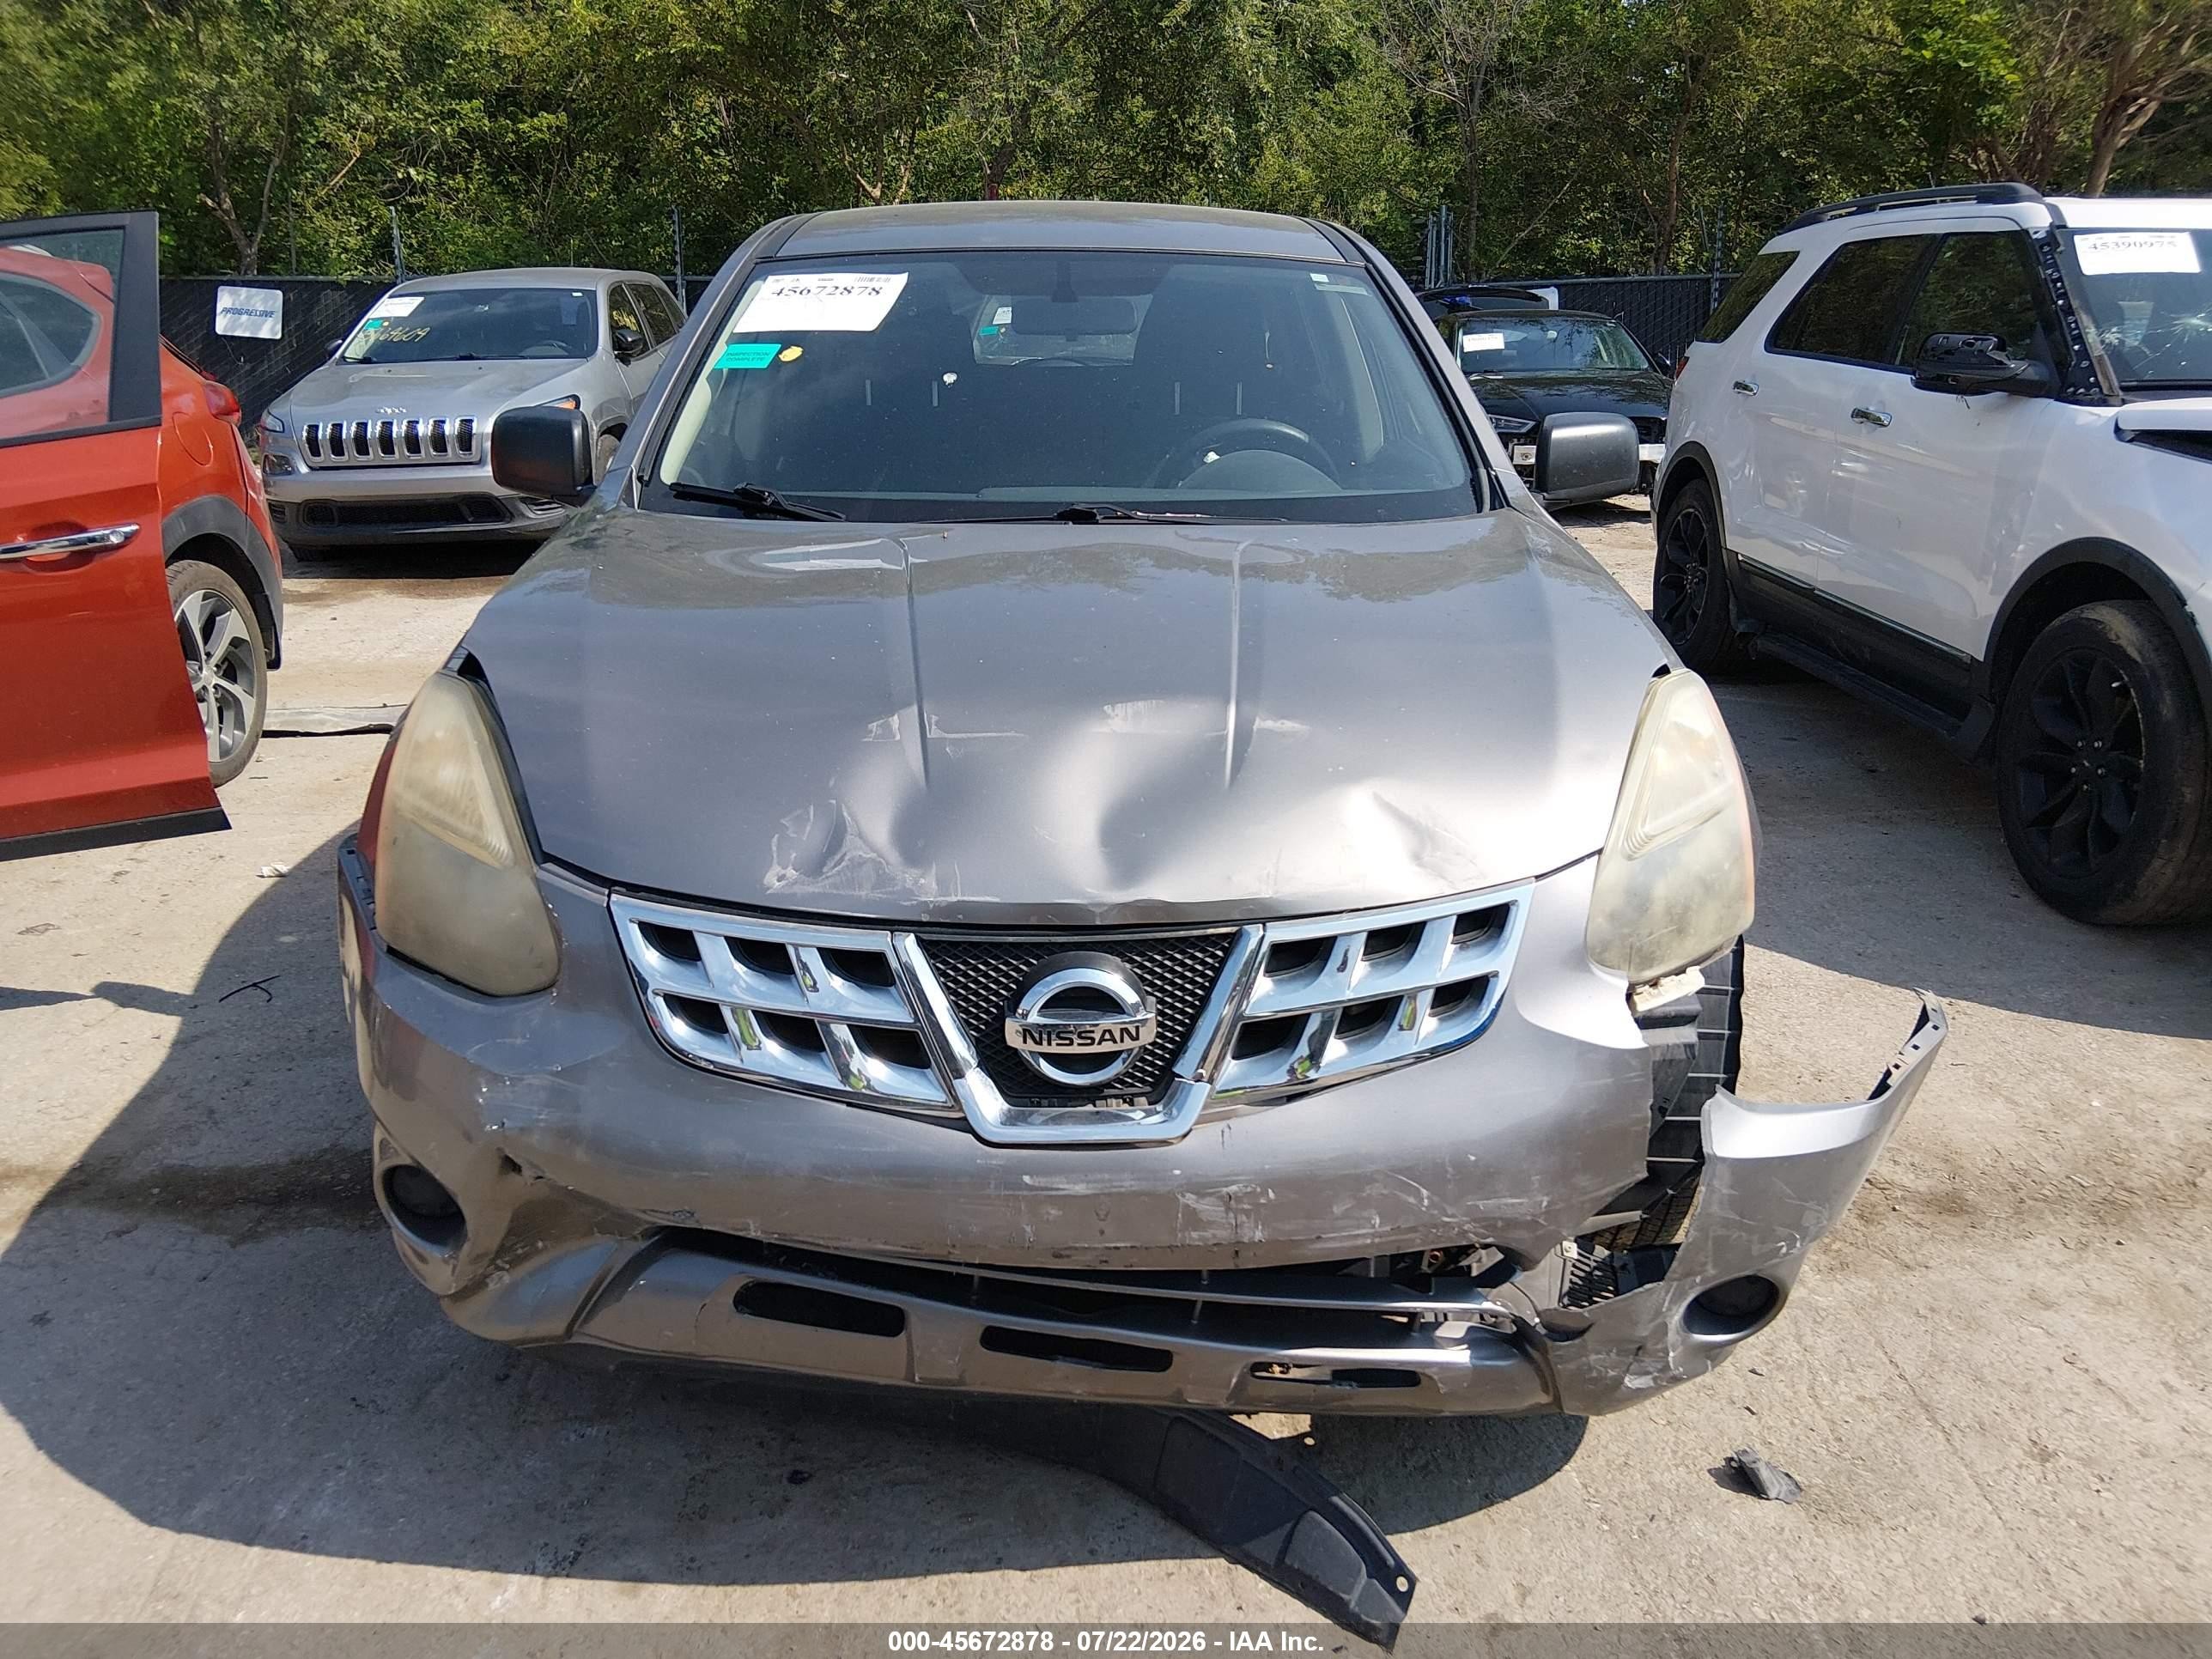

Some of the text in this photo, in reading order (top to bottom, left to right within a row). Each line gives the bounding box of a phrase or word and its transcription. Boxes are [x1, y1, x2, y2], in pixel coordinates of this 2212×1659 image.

[2088, 240, 2178, 251] 45390975
[771, 285, 884, 297] 45672878
[220, 307, 276, 319] PROGRESSIVE
[1022, 1025, 1140, 1047] NISSAN
